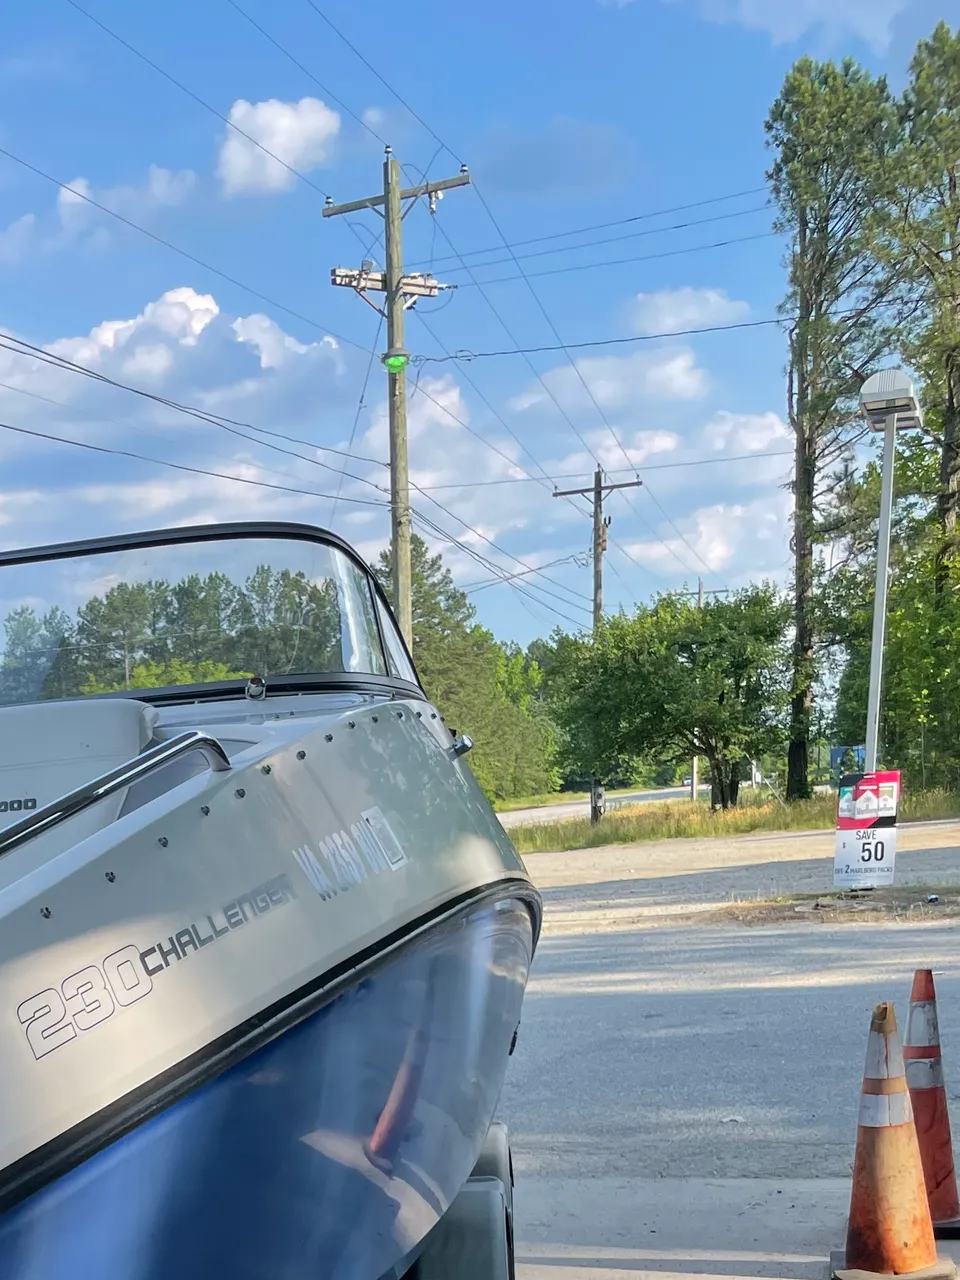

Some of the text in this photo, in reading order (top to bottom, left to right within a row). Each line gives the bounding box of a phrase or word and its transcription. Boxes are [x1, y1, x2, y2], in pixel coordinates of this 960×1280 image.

[856, 830, 876, 840] SAVE
[844, 864, 850, 874] 2
[15, 872, 298, 1060] 230 CHALLENGER
